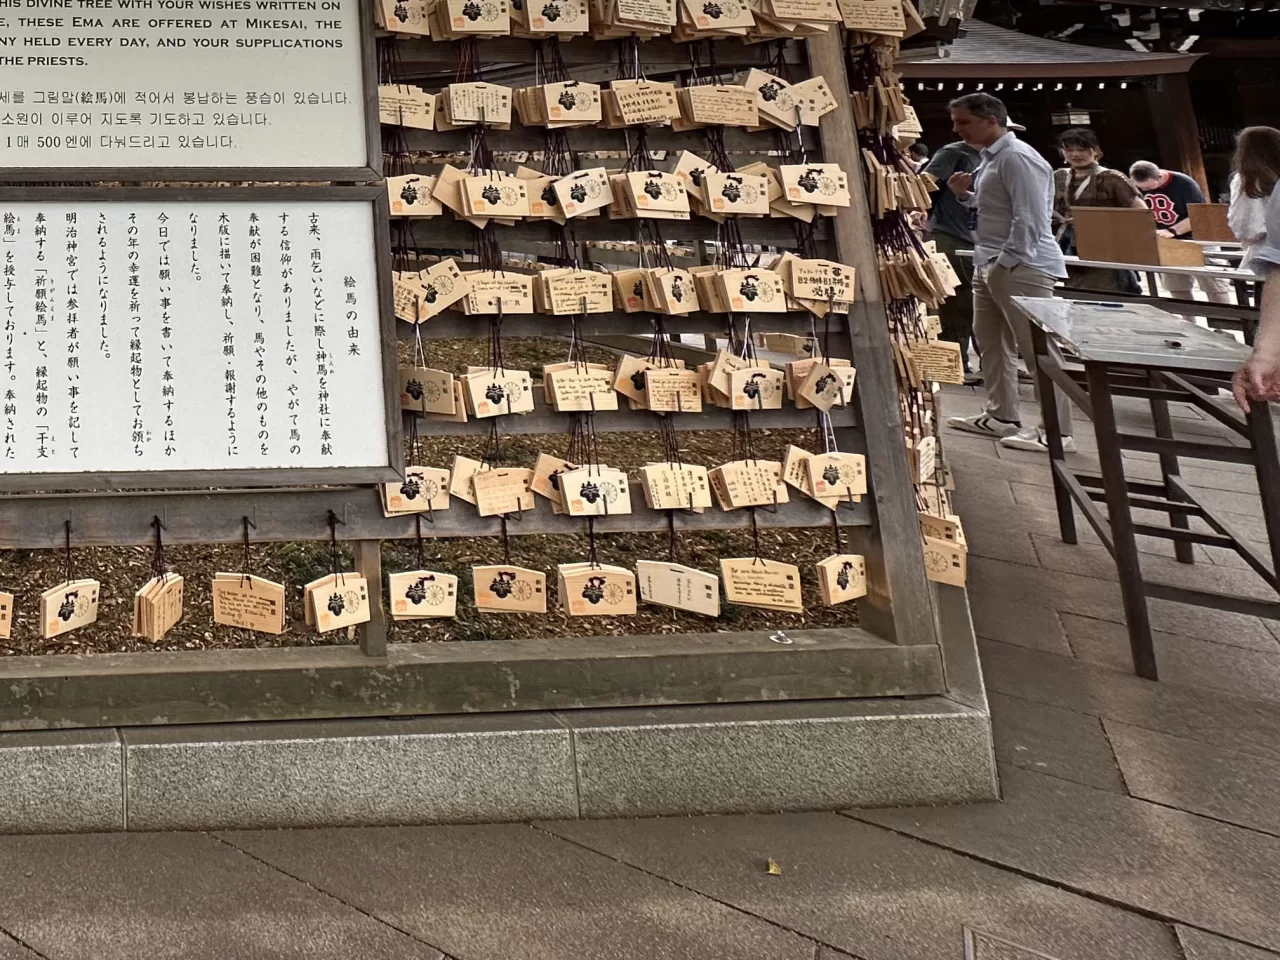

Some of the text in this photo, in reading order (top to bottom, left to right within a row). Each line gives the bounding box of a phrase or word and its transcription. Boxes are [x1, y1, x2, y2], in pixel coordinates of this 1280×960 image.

[76, 0, 113, 9] TREE
[117, 0, 153, 9] WITH
[157, 0, 194, 10] YOUR
[198, 0, 252, 10] WISHES
[255, 0, 317, 11] WRITTEN
[321, 1, 341, 11] ON
[17, 17, 64, 28] THESE
[72, 16, 104, 28] EMA
[111, 18, 141, 28] ARE
[147, 18, 213, 29] OFFERED
[220, 19, 238, 29] AT
[245, 17, 308, 31] MIKESAI,
[314, 20, 343, 30] THE
[23, 36, 61, 47] HELD
[67, 37, 114, 47] EVERY
[119, 37, 150, 48] DAY,
[156, 37, 187, 48] AND
[192, 38, 230, 48] YOUR
[235, 38, 344, 49] SUPPLICATIONS
[27, 56, 89, 66] PRIESTS.
[134, 91, 175, 105] 적어서
[182, 91, 238, 105] 봉납하는
[245, 91, 285, 105] 풍습이
[293, 91, 352, 105] 있습니다.
[1, 112, 43, 126] 소원이
[149, 112, 205, 126] 기도하고
[212, 112, 272, 127] 있습니다.
[37, 135, 61, 149] 500
[177, 135, 237, 149] 있습니다.
[188, 212, 202, 282] なりました。
[96, 212, 111, 359] されるようになりました。
[343, 275, 361, 356] 絵馬の由来
